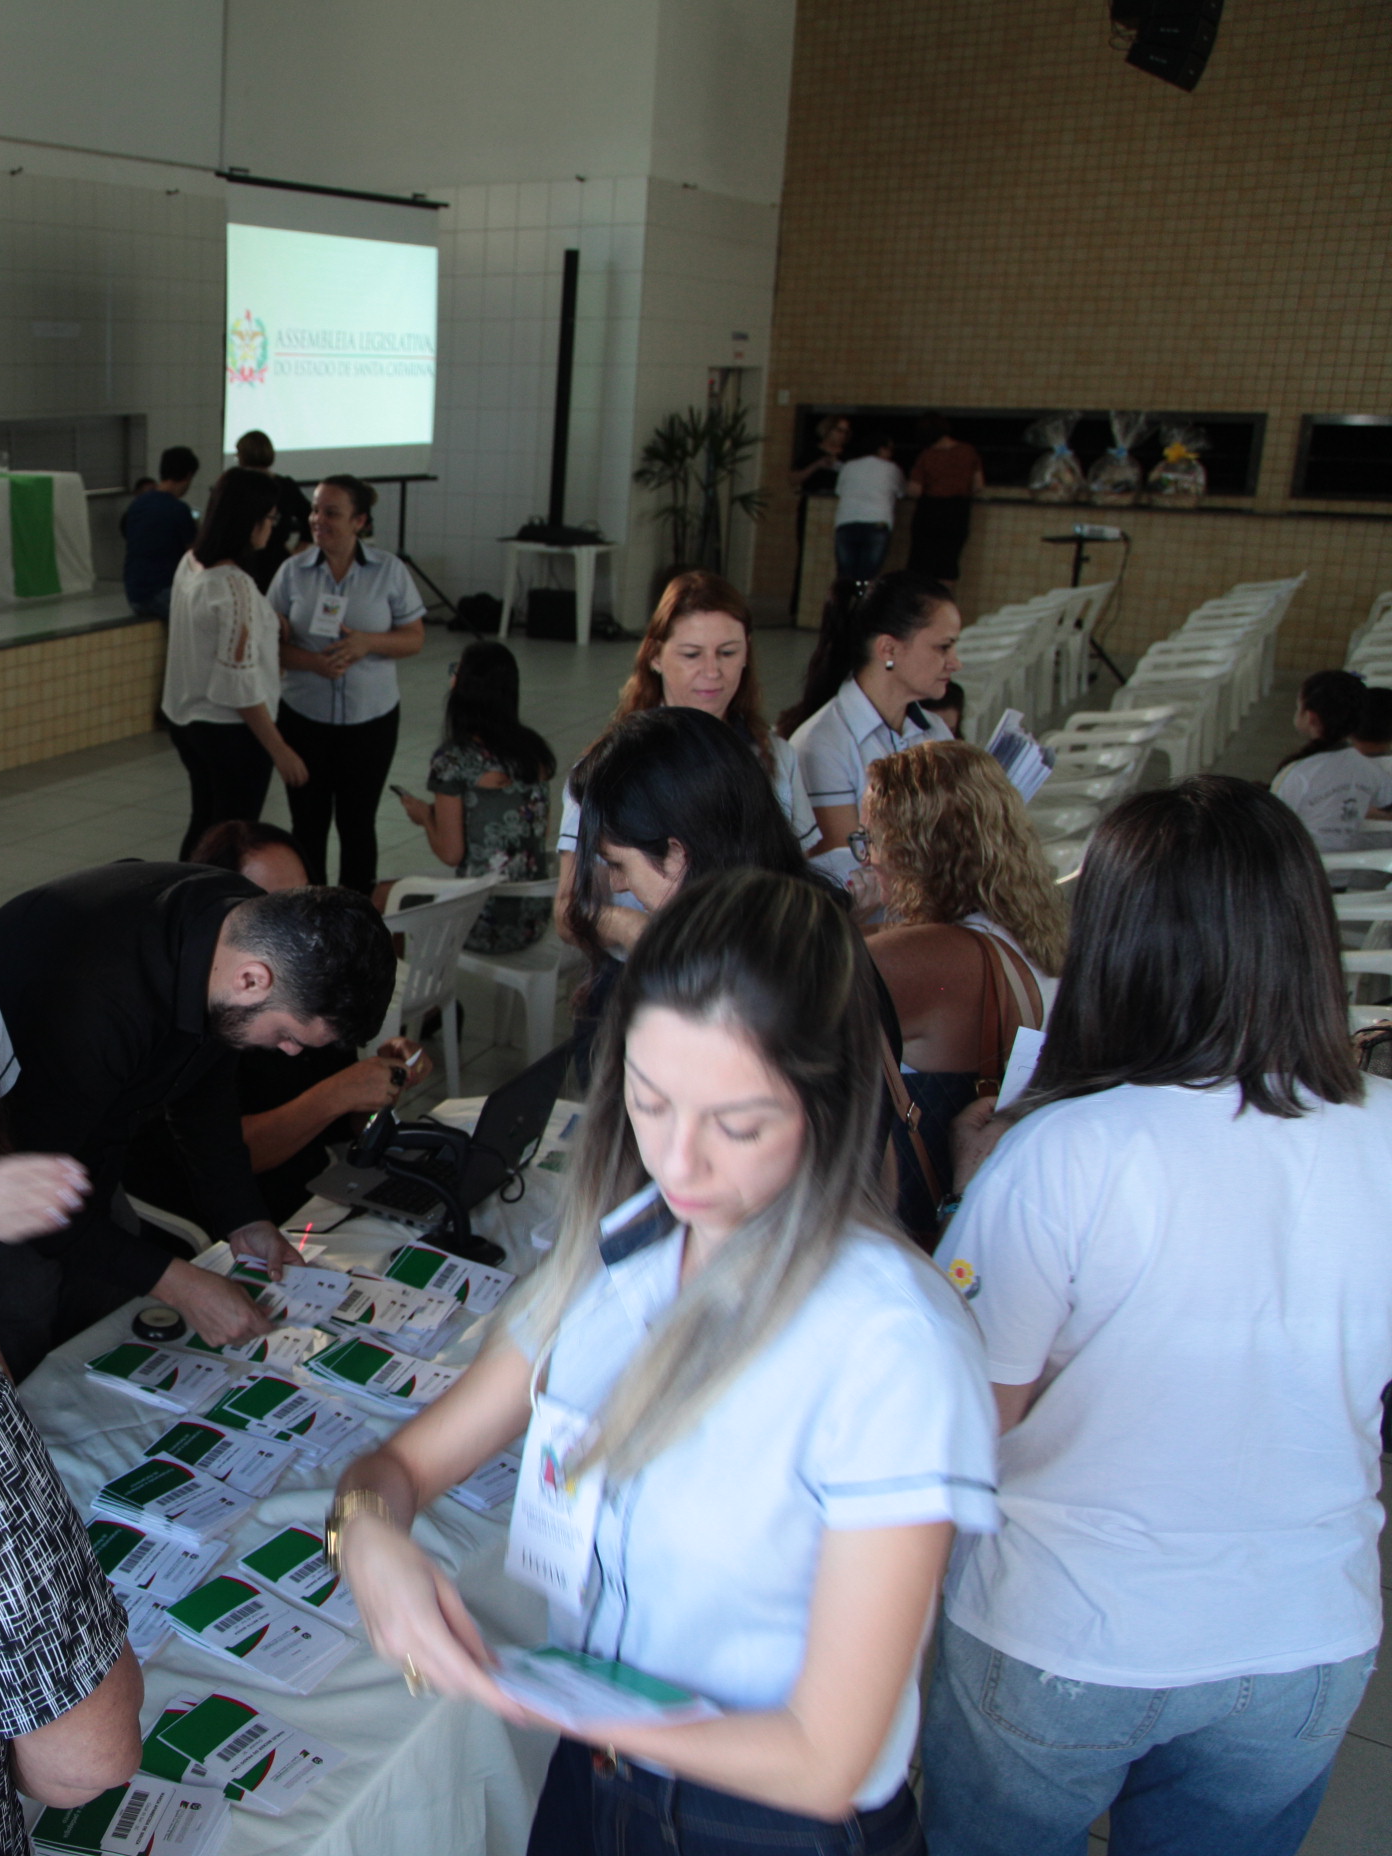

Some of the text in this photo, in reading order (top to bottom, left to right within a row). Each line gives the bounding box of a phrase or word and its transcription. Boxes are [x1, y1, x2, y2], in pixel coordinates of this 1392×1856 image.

[275, 327, 356, 351] ASSEMBLEIA
[274, 358, 292, 376] DO
[293, 359, 336, 377] ESTADO
[337, 360, 353, 377] DE
[354, 361, 385, 378] SANTA
